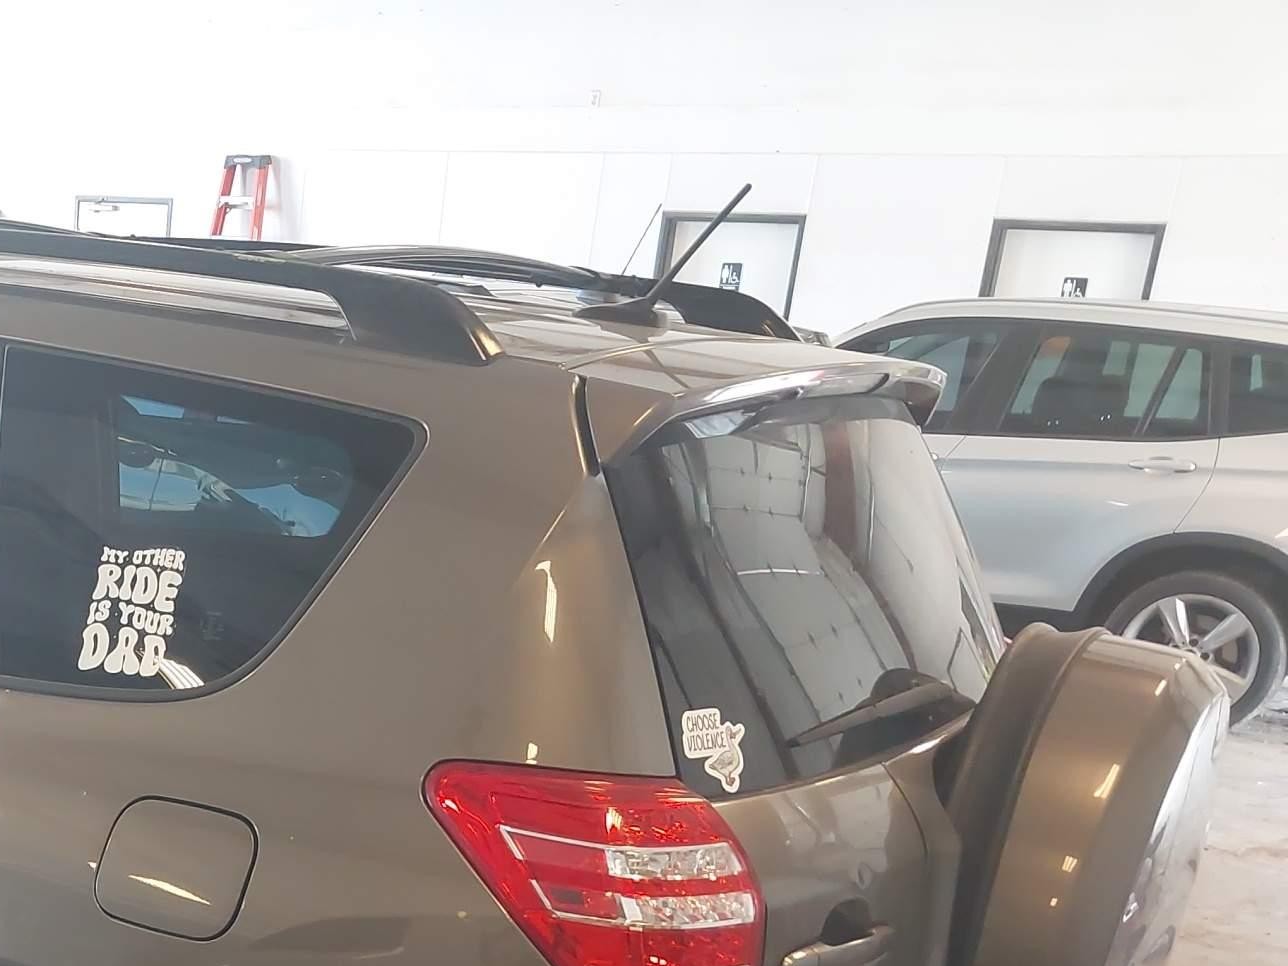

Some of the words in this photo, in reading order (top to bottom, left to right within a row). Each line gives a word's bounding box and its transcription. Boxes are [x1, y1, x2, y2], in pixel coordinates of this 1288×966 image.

[100, 546, 129, 564] MY
[132, 548, 187, 571] OTHER
[92, 563, 183, 612] RIDE
[87, 600, 112, 625] IS
[118, 601, 175, 636] YOUR
[77, 622, 167, 677] DAD
[686, 712, 720, 733] CHOOSE
[687, 731, 727, 752] VIOLENCE
